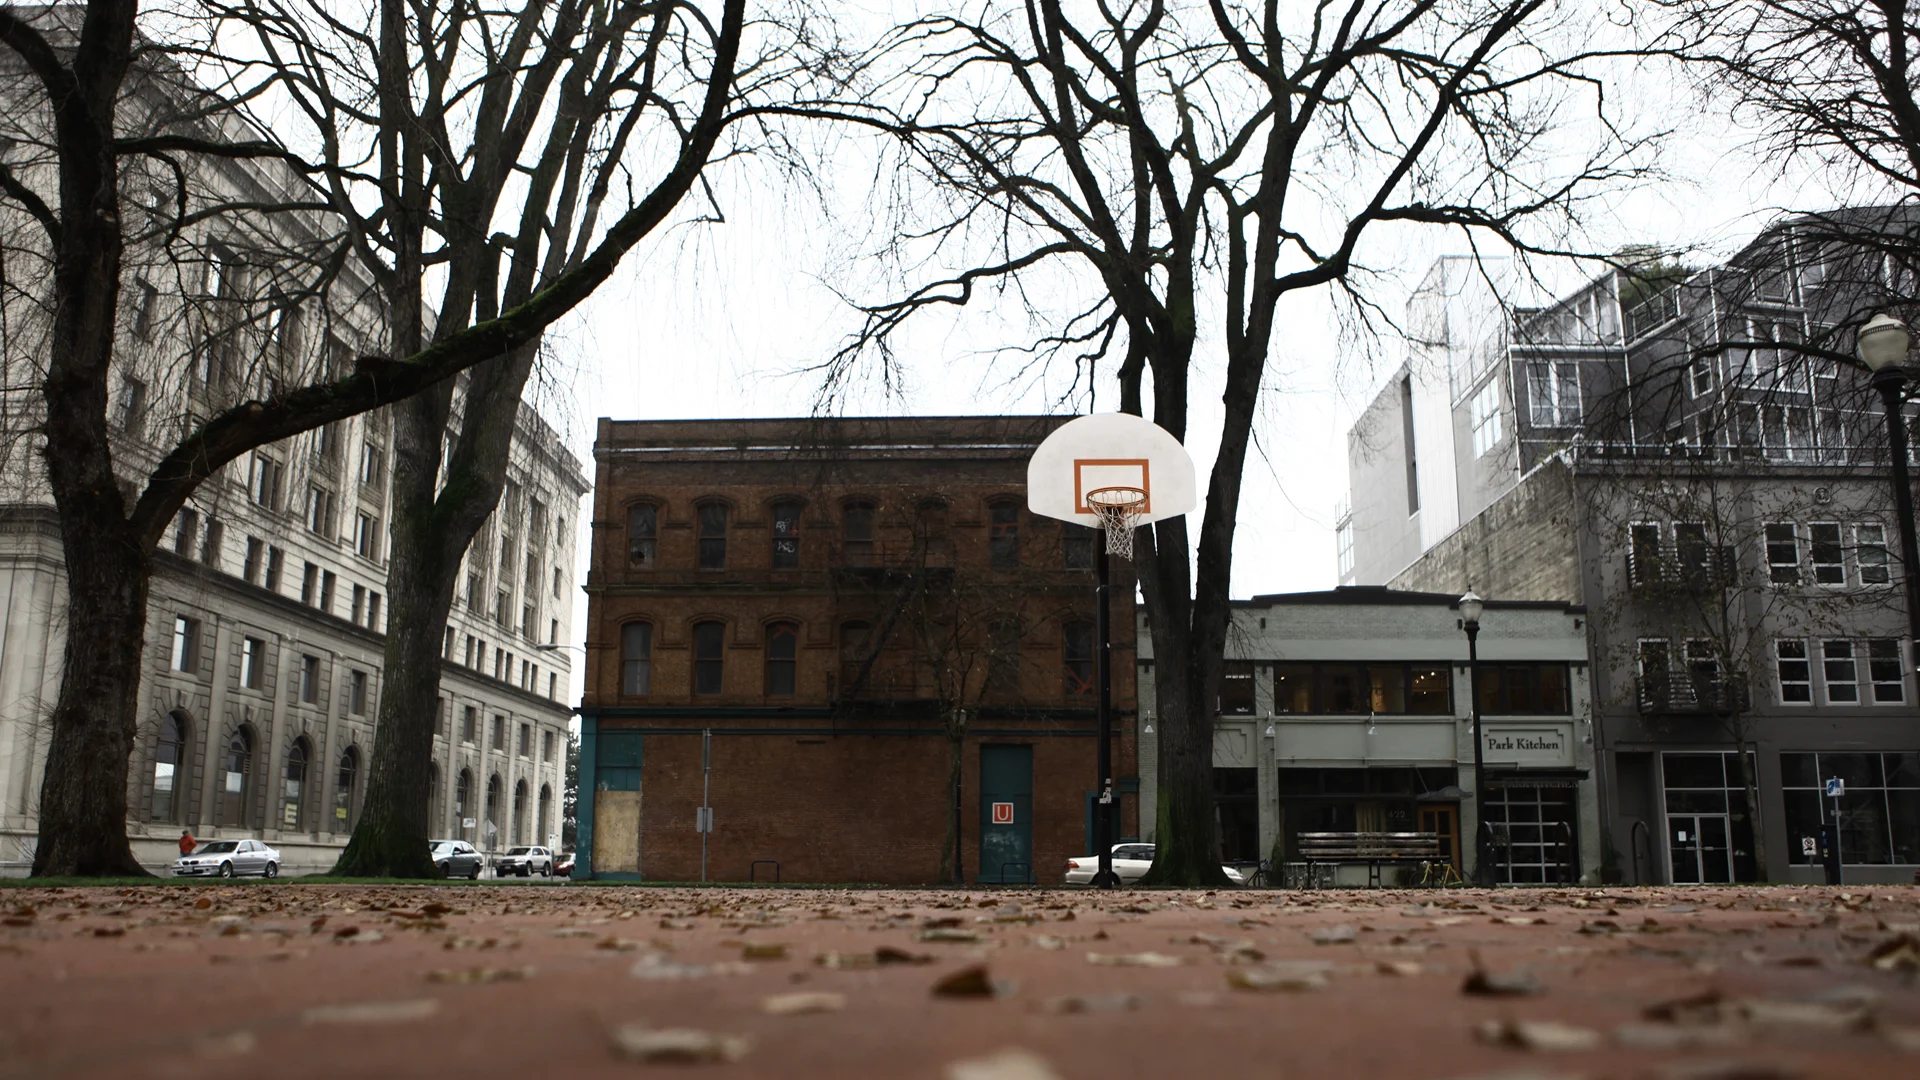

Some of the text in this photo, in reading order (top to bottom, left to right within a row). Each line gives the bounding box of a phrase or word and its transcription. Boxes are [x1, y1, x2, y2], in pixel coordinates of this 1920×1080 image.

[1488, 736, 1559, 750] Park Kitchen
[997, 805, 1009, 821] U
